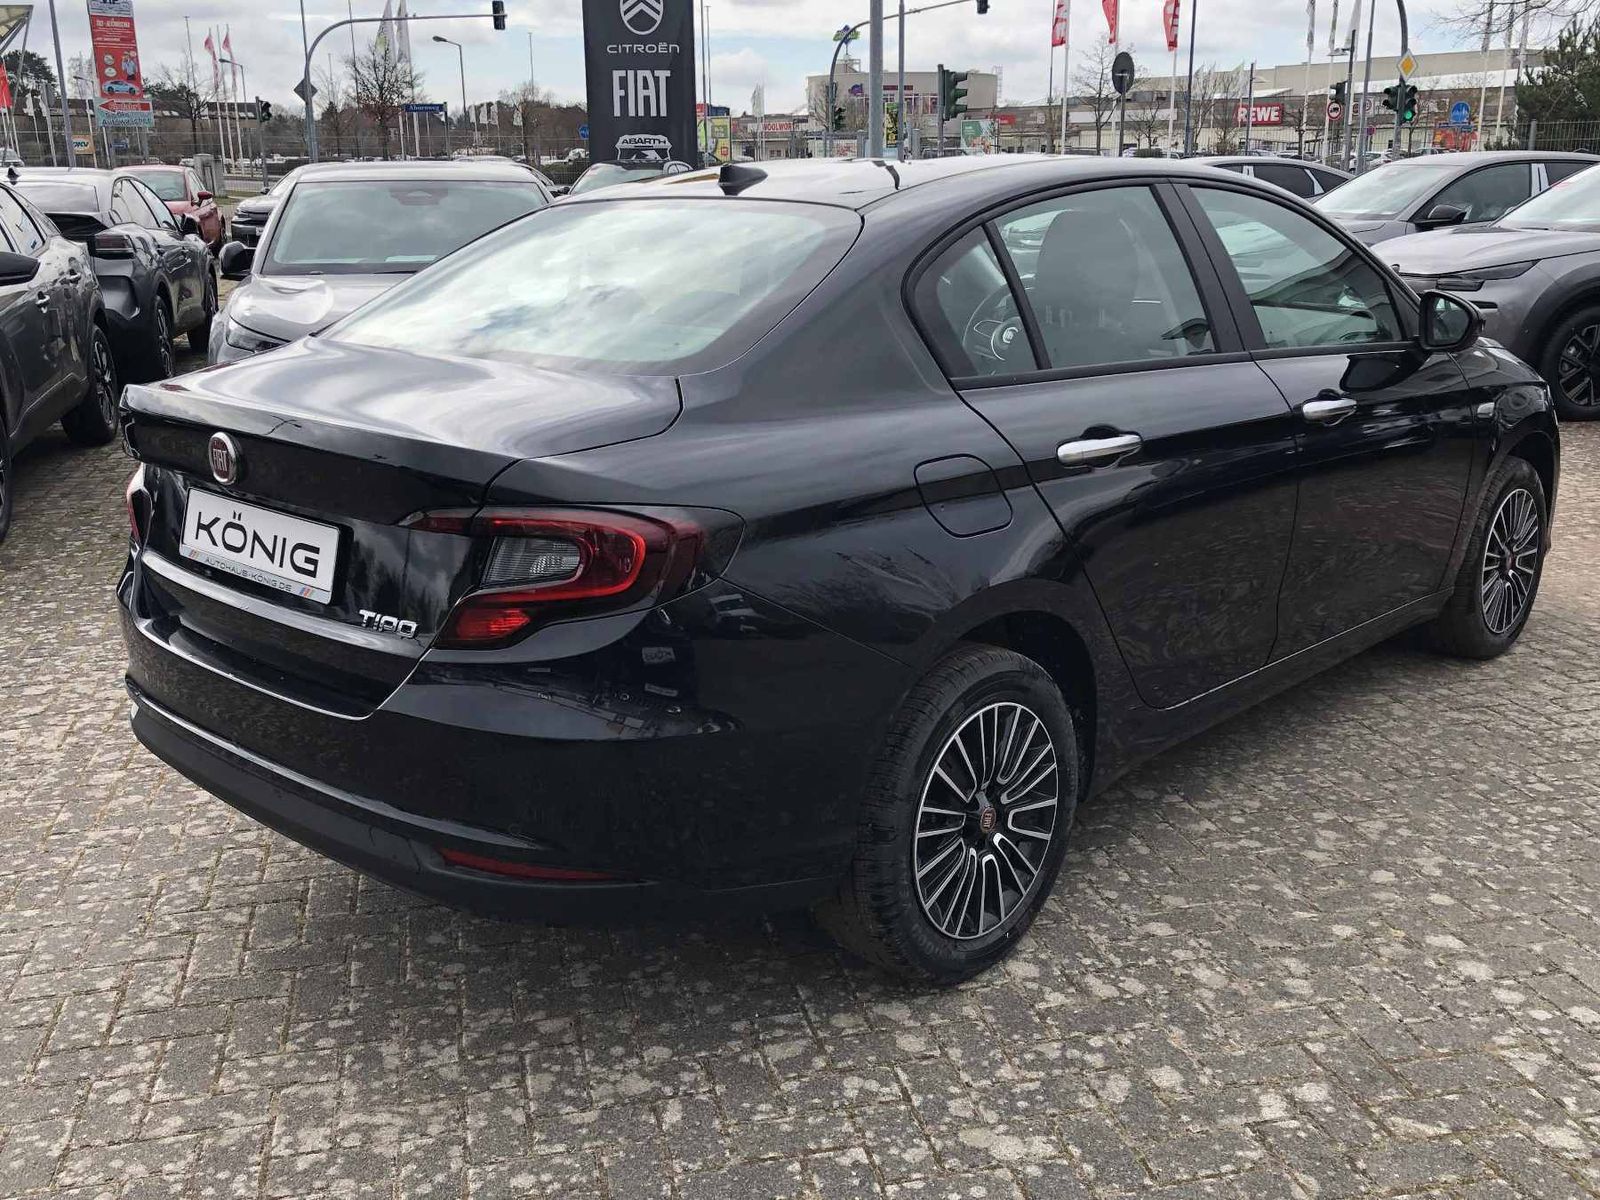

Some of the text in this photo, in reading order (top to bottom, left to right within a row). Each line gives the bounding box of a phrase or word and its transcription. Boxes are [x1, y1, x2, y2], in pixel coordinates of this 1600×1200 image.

[606, 41, 680, 54] CITROËN
[612, 69, 671, 118] FIAT
[1237, 106, 1280, 122] REWE
[762, 121, 800, 131] WOOLWORH
[621, 137, 666, 145] ABARTH
[212, 448, 228, 472] FIAT
[195, 509, 320, 578] KÖNIG
[358, 608, 420, 640] TIPO
